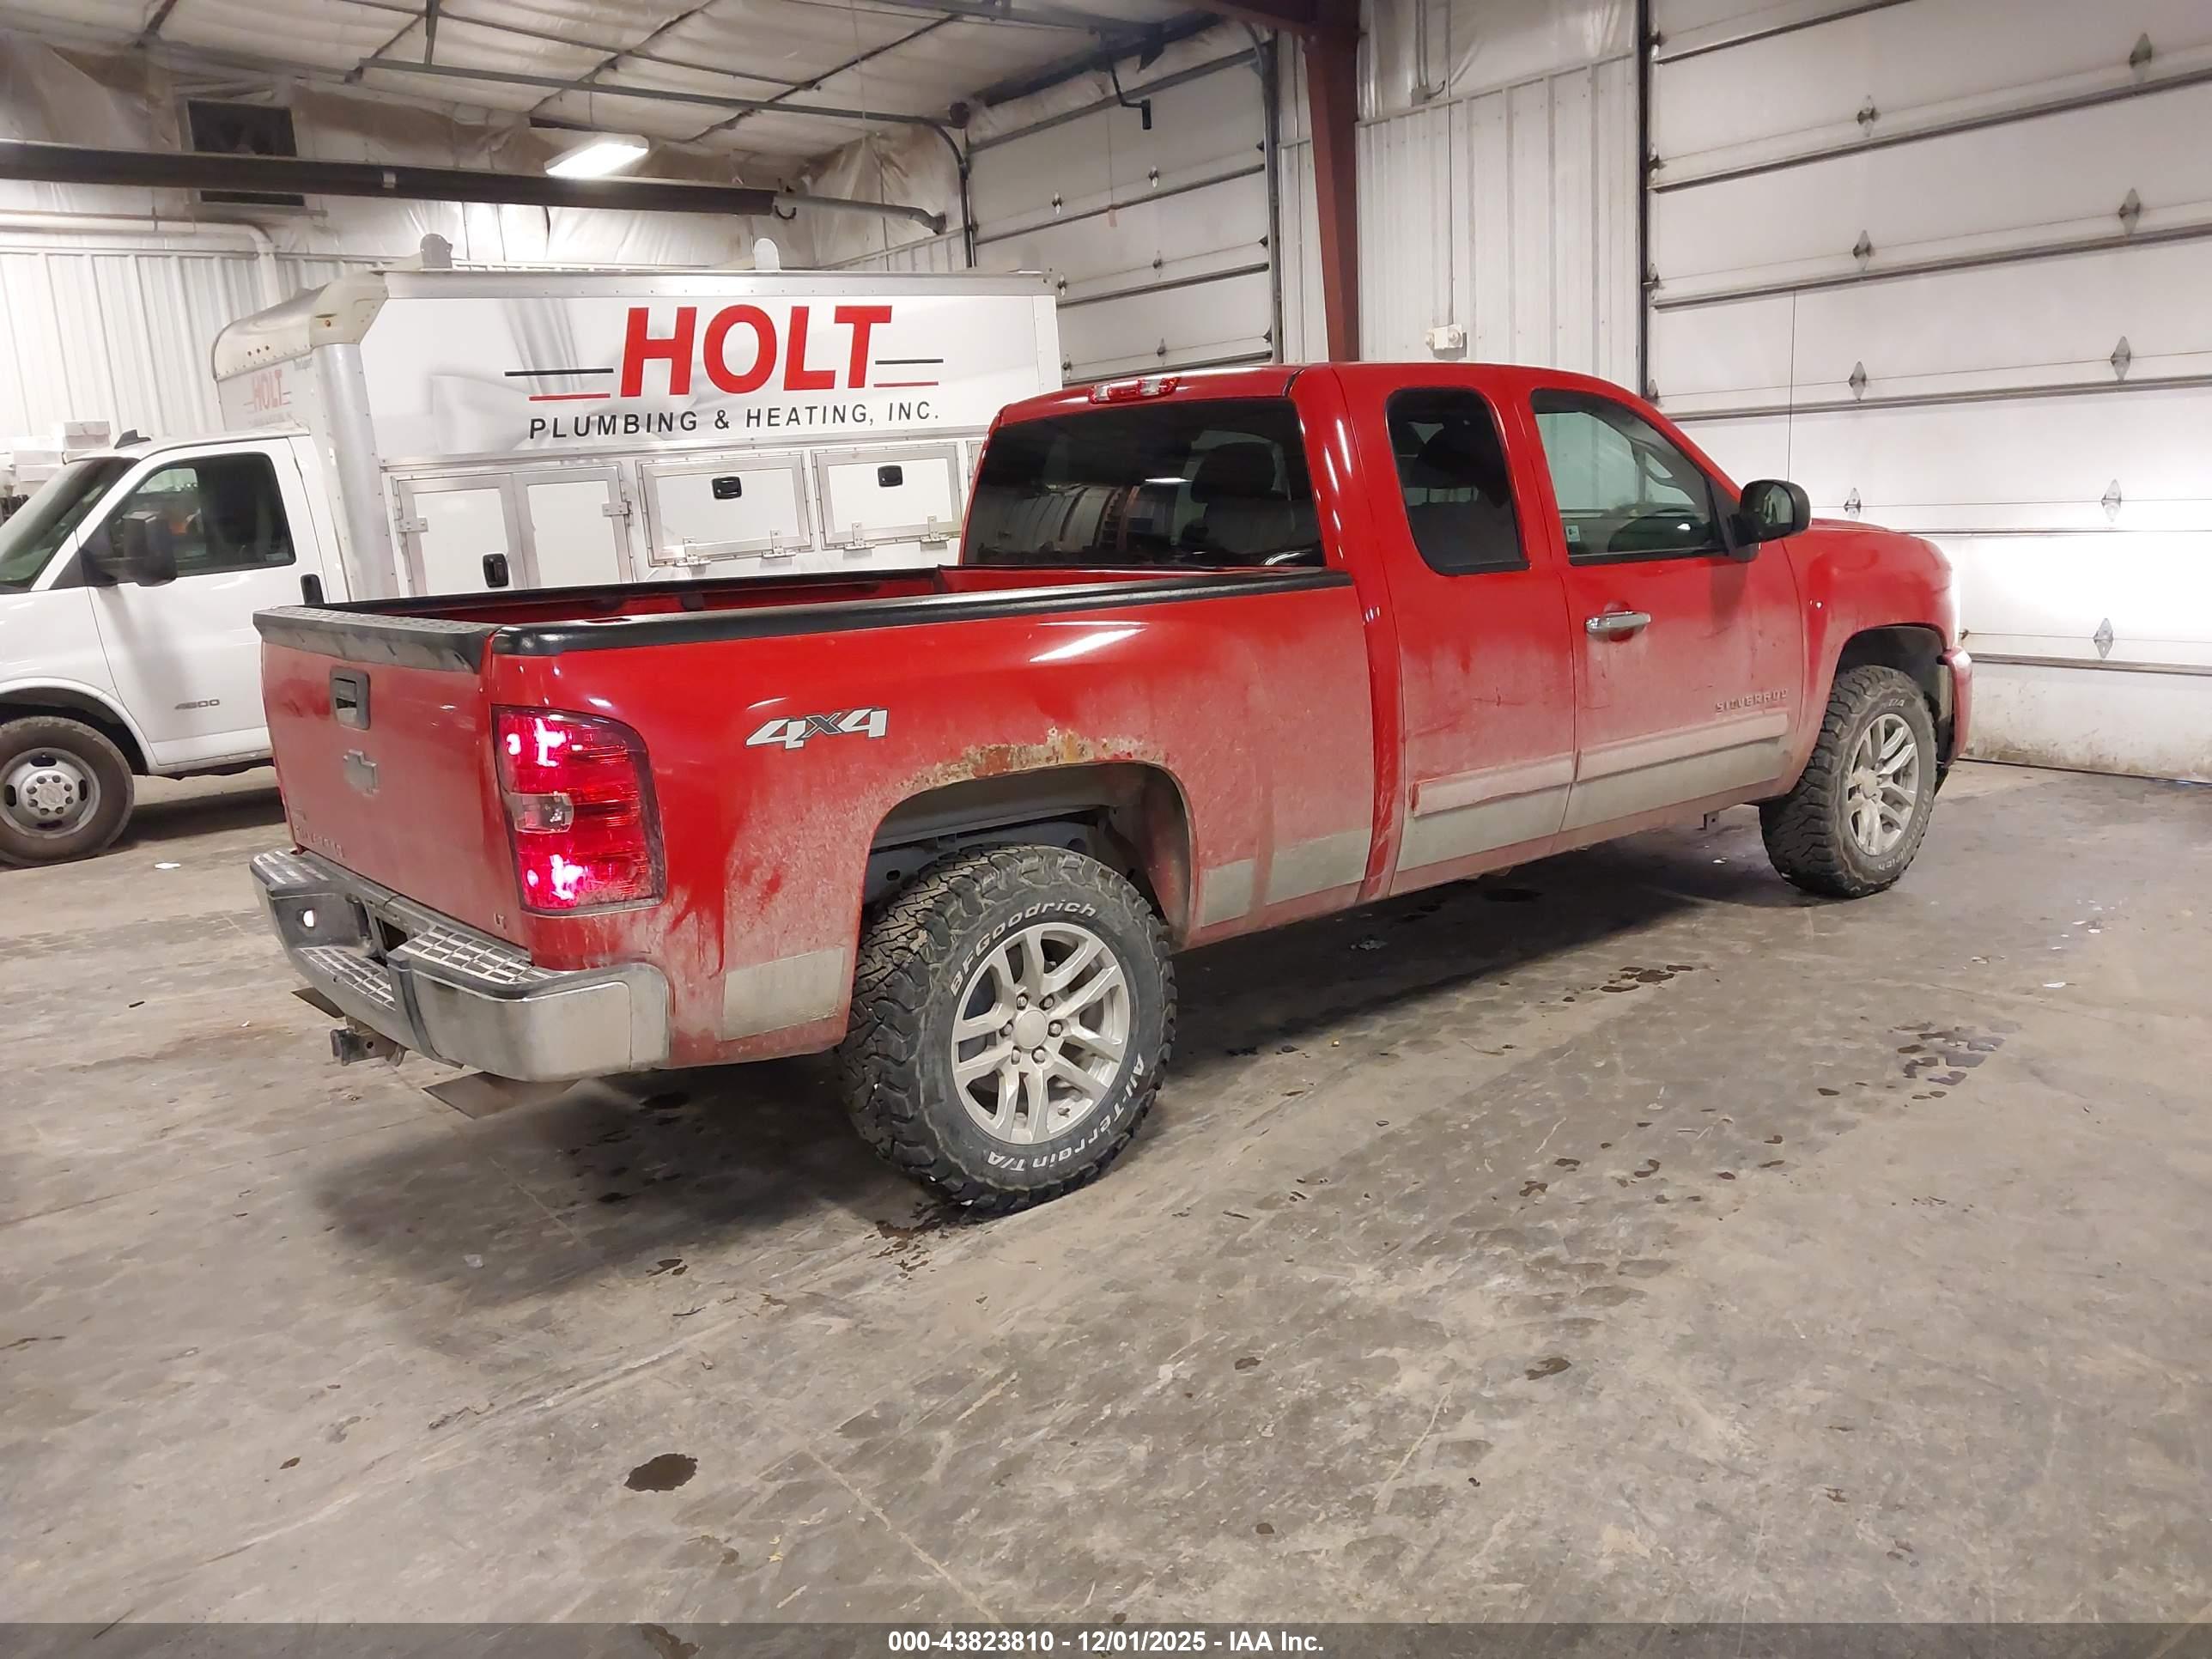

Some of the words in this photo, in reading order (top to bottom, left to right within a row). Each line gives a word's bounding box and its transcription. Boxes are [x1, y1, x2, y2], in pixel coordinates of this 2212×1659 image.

[620, 304, 893, 398] HOLT
[252, 369, 283, 413] HOLT
[529, 410, 697, 439] PLUMBING
[714, 409, 730, 429] &
[746, 404, 873, 428] HEATING,
[889, 401, 939, 422] INC.
[951, 899, 1097, 996] BFGoodrich
[988, 1150, 1025, 1172] T/A
